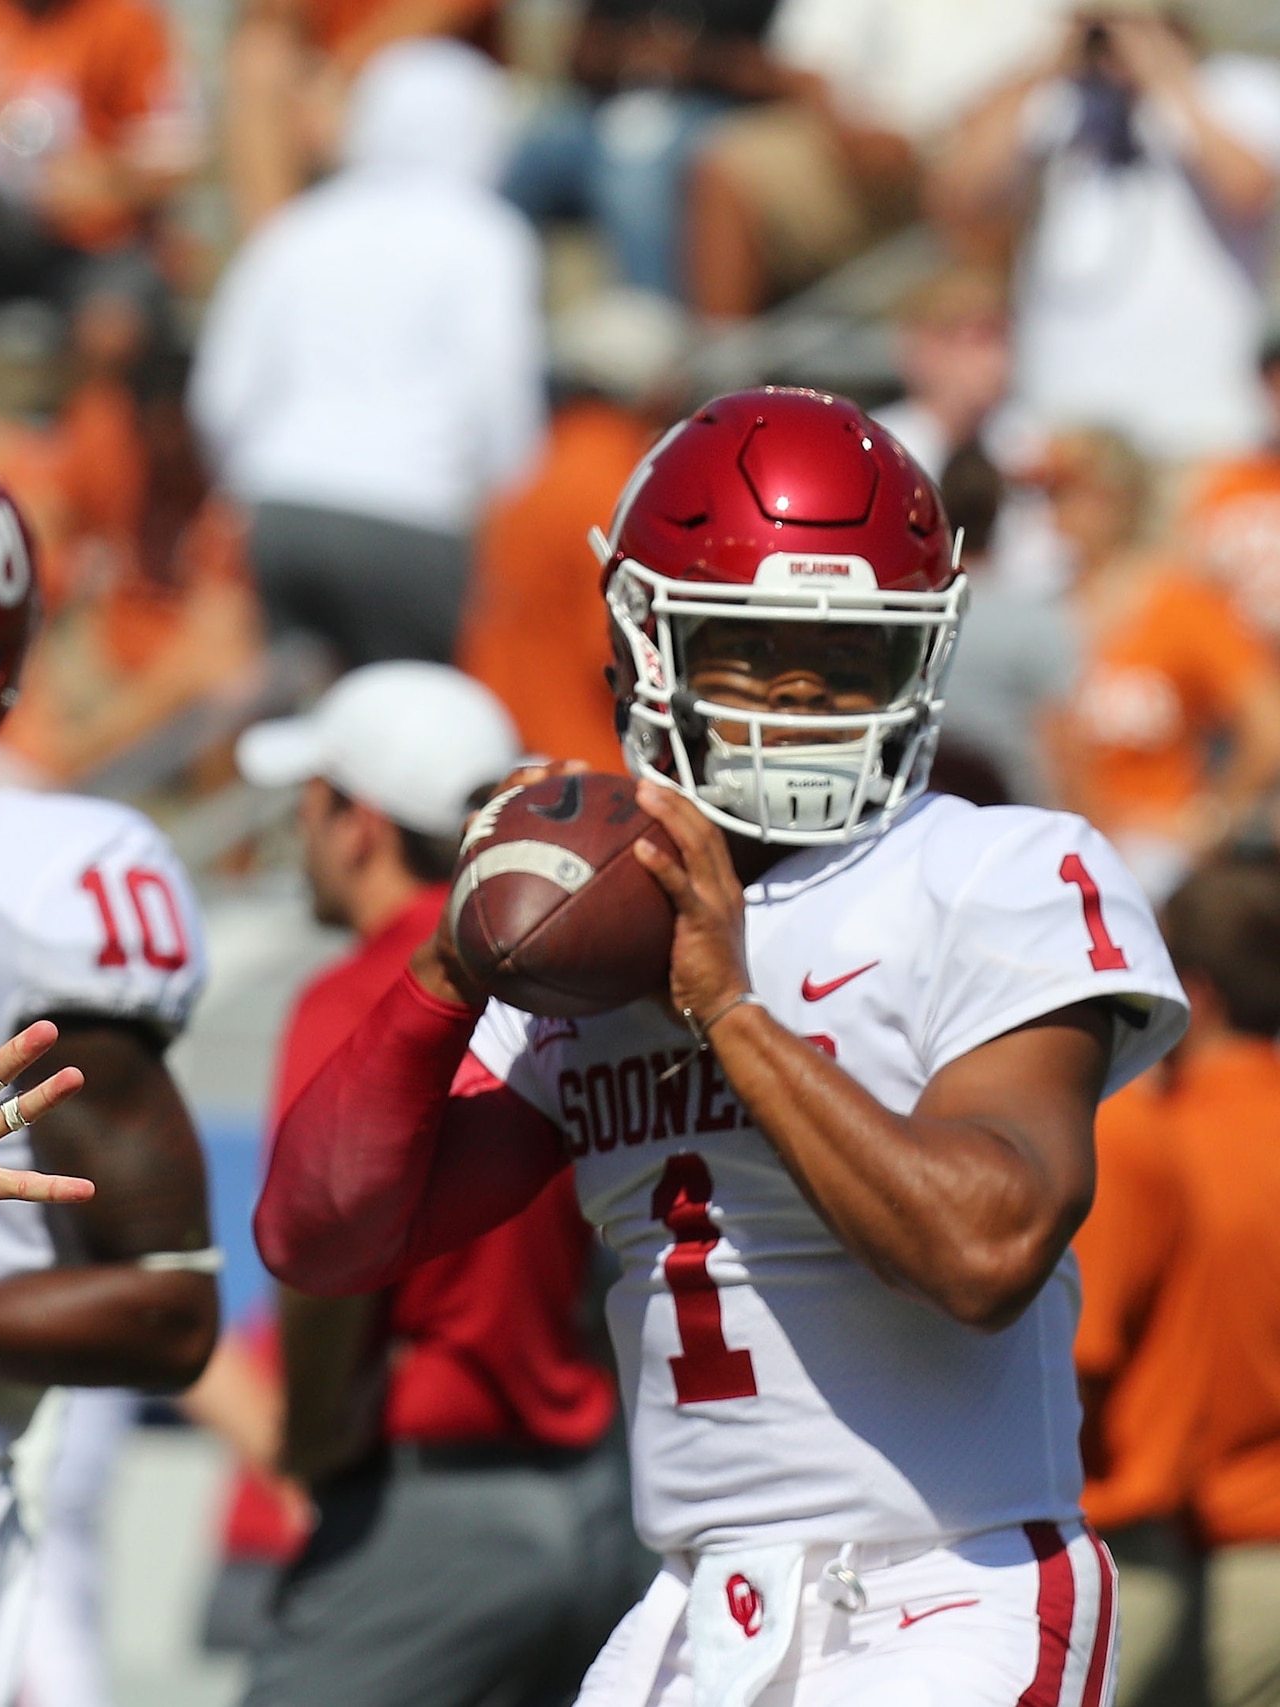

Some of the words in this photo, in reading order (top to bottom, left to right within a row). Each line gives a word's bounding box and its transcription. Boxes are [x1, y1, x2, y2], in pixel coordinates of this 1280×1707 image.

[81, 864, 188, 972] 10
[1059, 854, 1129, 972] 1
[649, 1151, 758, 1404] 1
